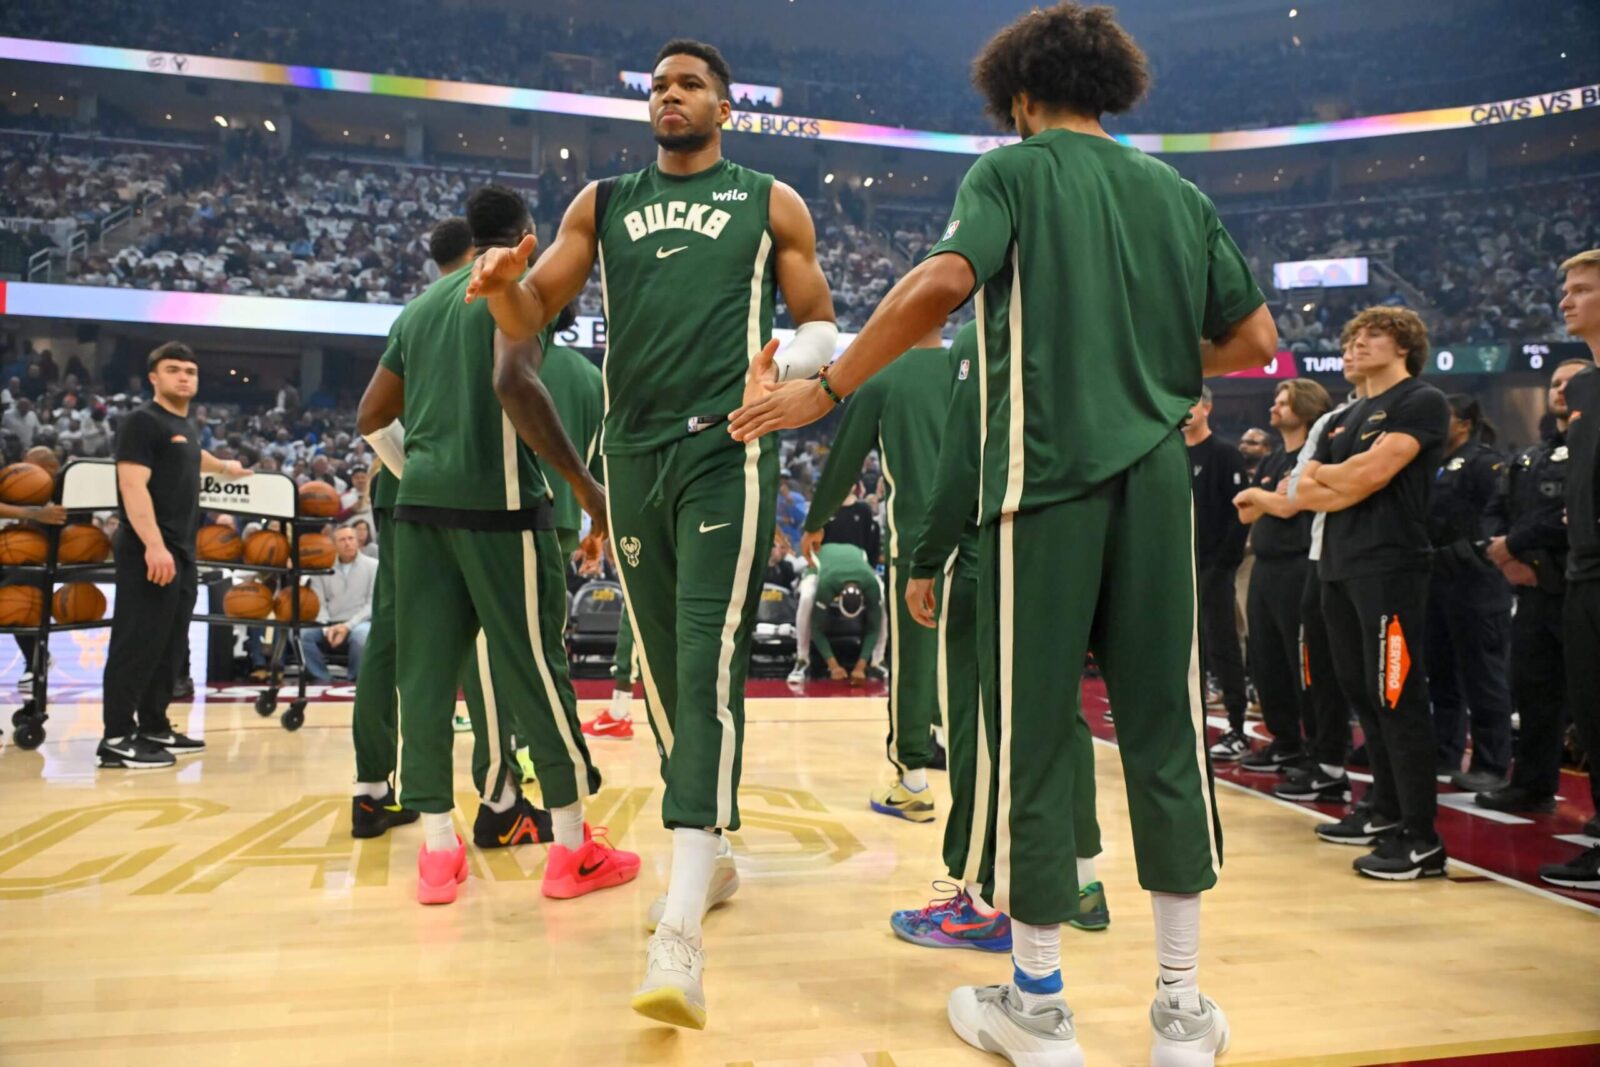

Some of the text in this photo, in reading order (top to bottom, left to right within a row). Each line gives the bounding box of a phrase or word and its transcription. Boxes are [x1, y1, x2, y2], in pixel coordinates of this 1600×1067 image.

[1471, 88, 1600, 124] CAVS VS B
[730, 112, 820, 136] VS BUCKS
[712, 189, 748, 201] wilo
[623, 201, 731, 242] BUCKS
[1436, 350, 1454, 371] 0
[1530, 354, 1543, 369] 0
[199, 476, 250, 495] lson
[1390, 635, 1402, 689] SERVPRO
